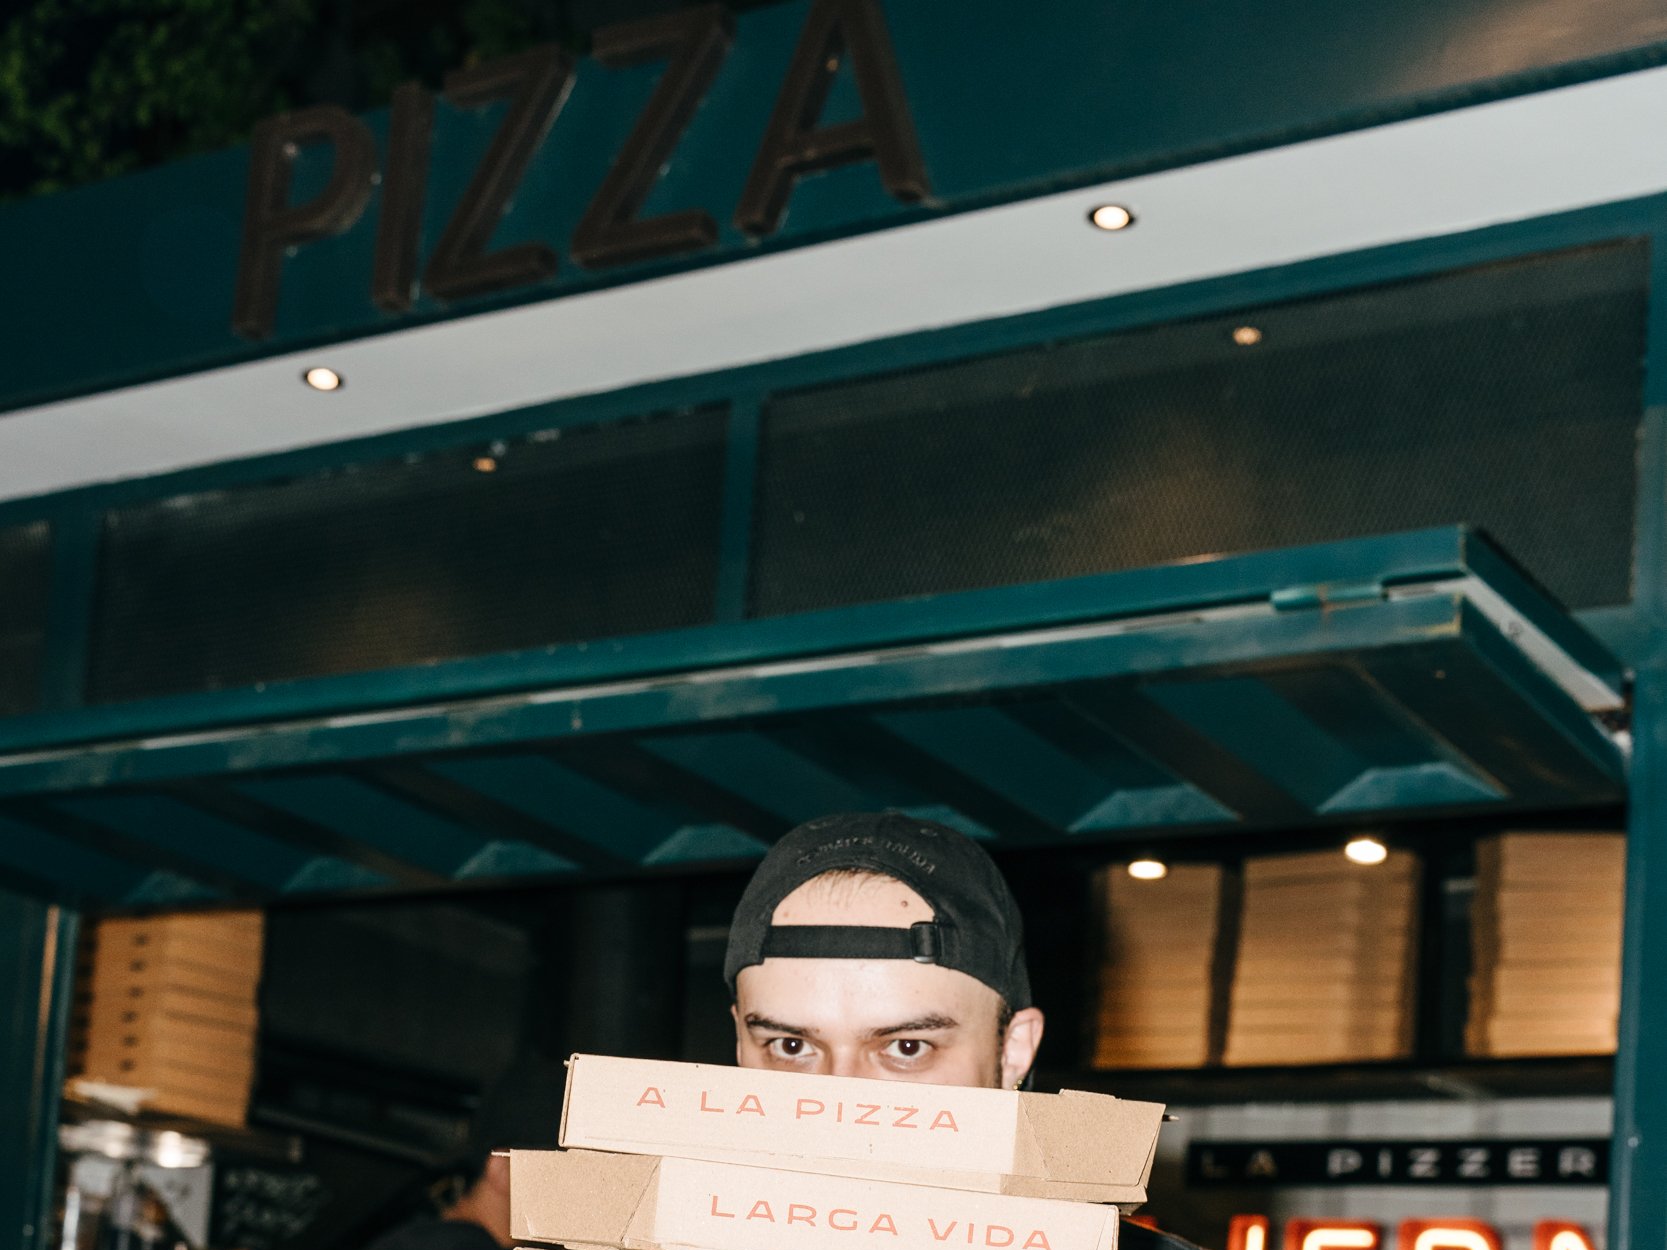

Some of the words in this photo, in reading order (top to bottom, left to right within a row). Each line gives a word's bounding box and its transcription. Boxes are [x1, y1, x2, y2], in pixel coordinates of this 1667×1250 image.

[230, 0, 930, 341] PIZZA
[638, 1086, 666, 1109] A
[700, 1090, 766, 1117] LA
[795, 1098, 959, 1132] PIZZA
[710, 1194, 899, 1236] LARGA
[928, 1218, 1052, 1250] VIDA
